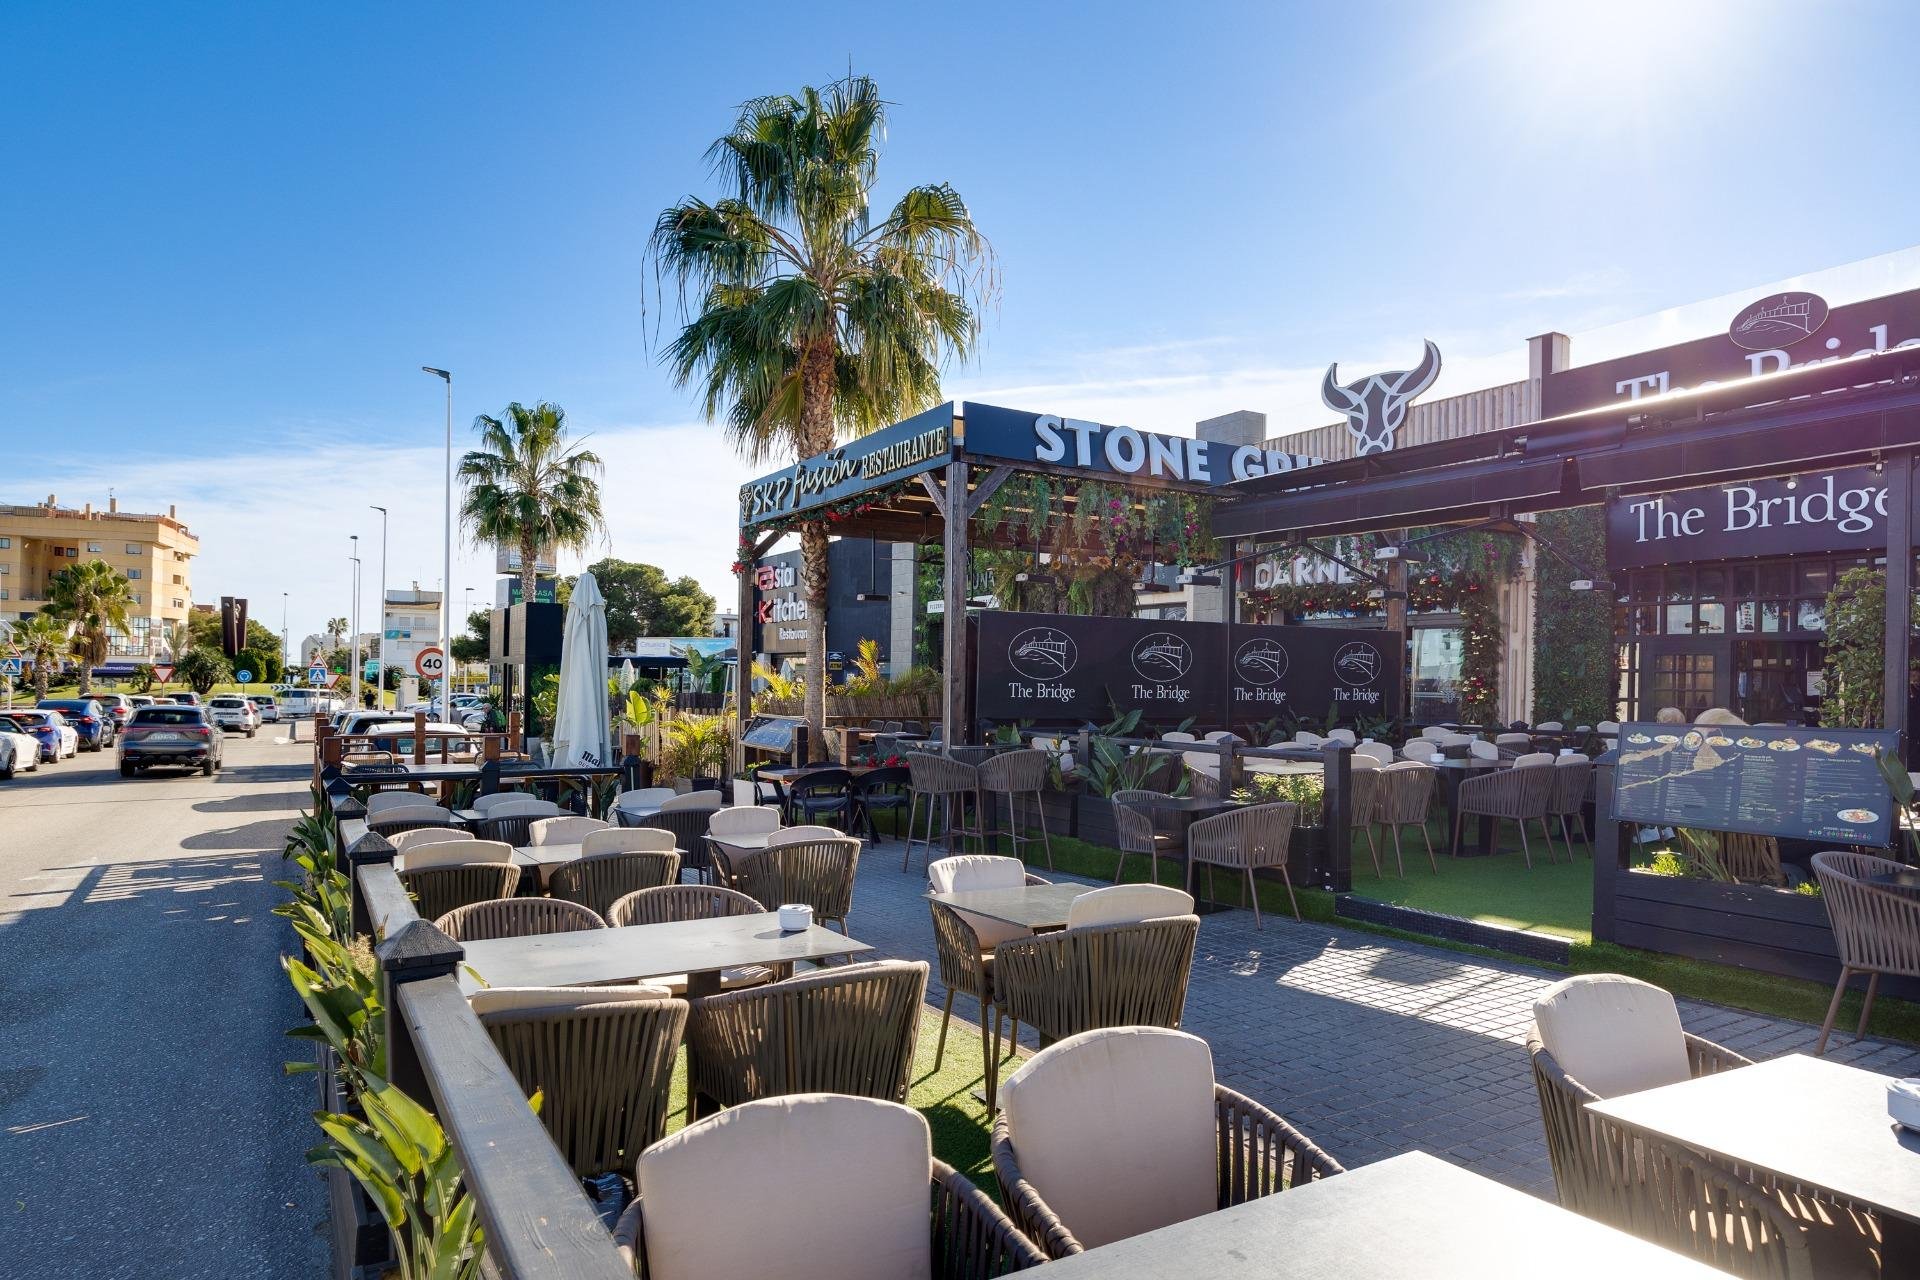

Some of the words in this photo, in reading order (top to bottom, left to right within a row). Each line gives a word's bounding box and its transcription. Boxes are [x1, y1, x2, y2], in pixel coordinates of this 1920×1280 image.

[1034, 413, 1211, 482] STONE
[752, 476, 790, 516] SKP
[790, 448, 861, 509] fusión
[861, 426, 946, 480] RESTAURANTE
[1629, 498, 1706, 543] The
[422, 658, 442, 669] 40
[1008, 682, 1033, 698] The
[1037, 682, 1076, 703] Bridge
[1131, 684, 1154, 700] The
[1156, 684, 1191, 703] Bridge
[1234, 686, 1254, 701] The
[1256, 687, 1287, 704] Bridge
[1333, 687, 1352, 702] The
[1353, 687, 1380, 704] Bridge
